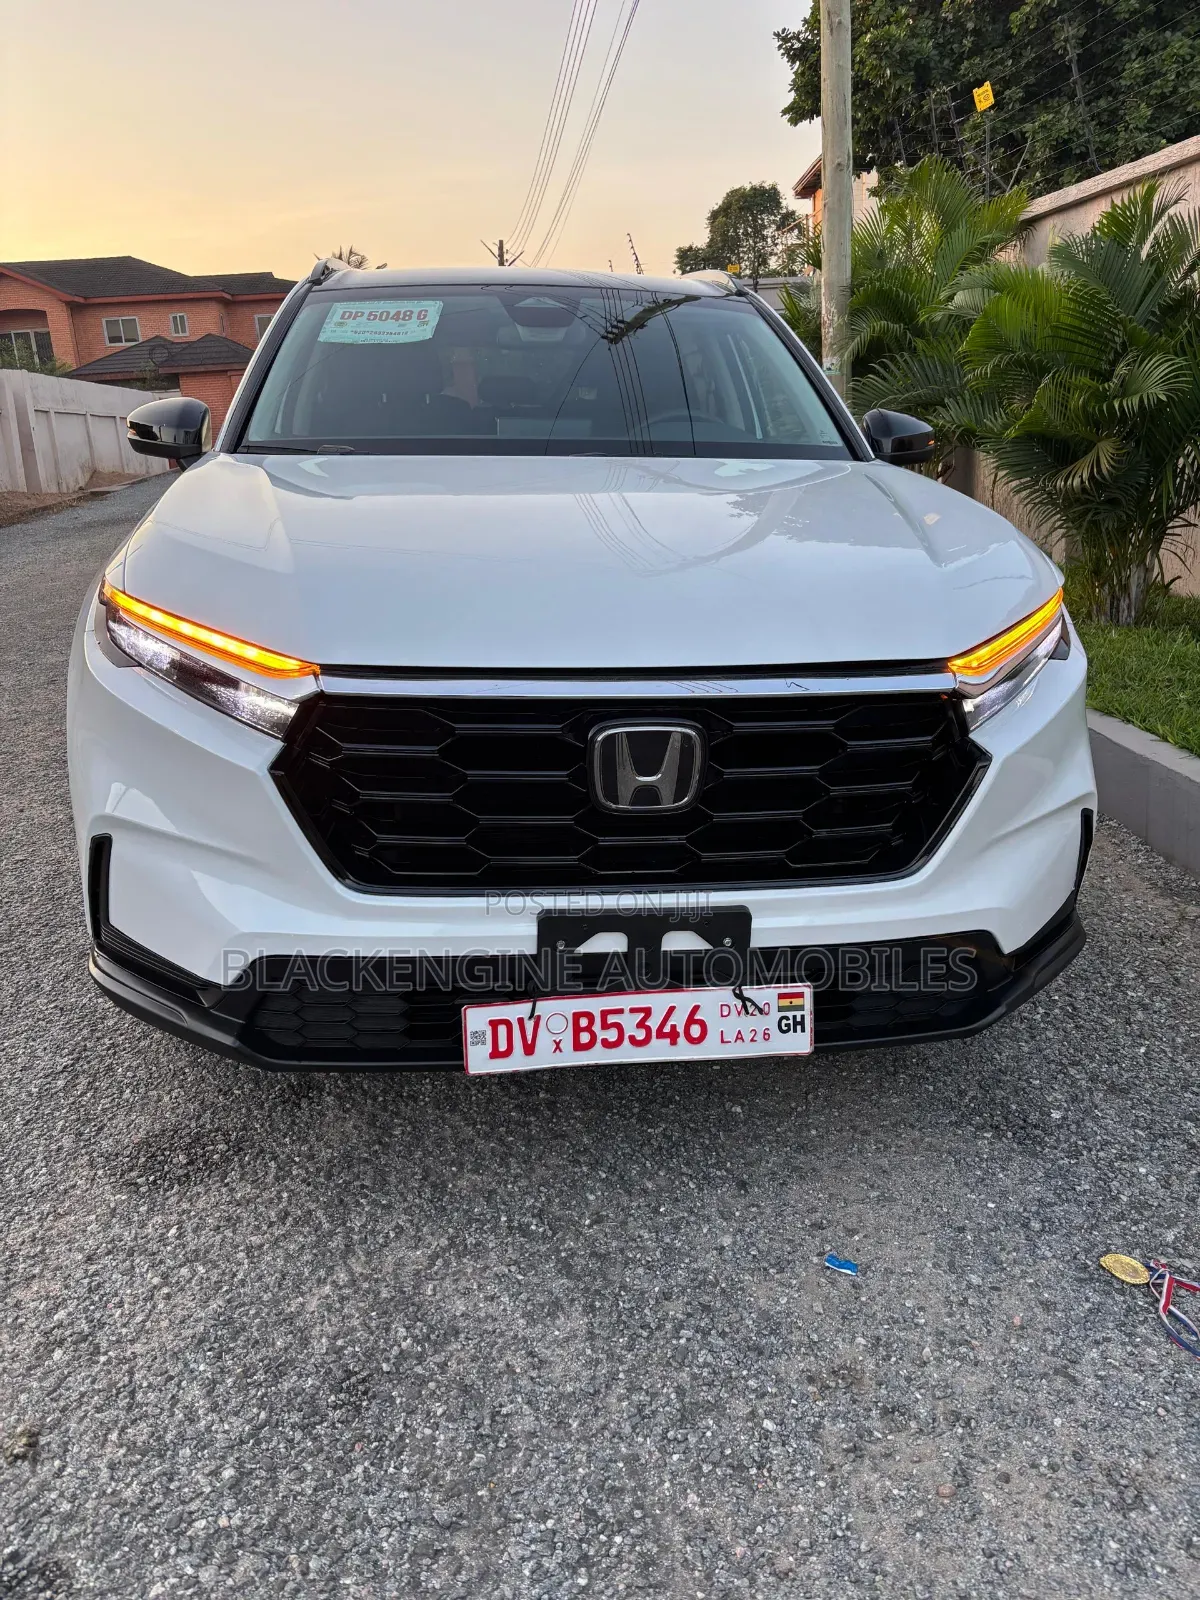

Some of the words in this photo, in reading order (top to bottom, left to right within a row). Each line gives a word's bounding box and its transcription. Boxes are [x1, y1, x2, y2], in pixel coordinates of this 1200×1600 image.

[340, 310, 365, 321] DP
[366, 310, 414, 322] 5048
[416, 309, 429, 321] G
[487, 1014, 542, 1060] DV
[572, 1003, 708, 1052] B5346
[777, 1013, 806, 1034] GH
[720, 1027, 771, 1044] LA26
